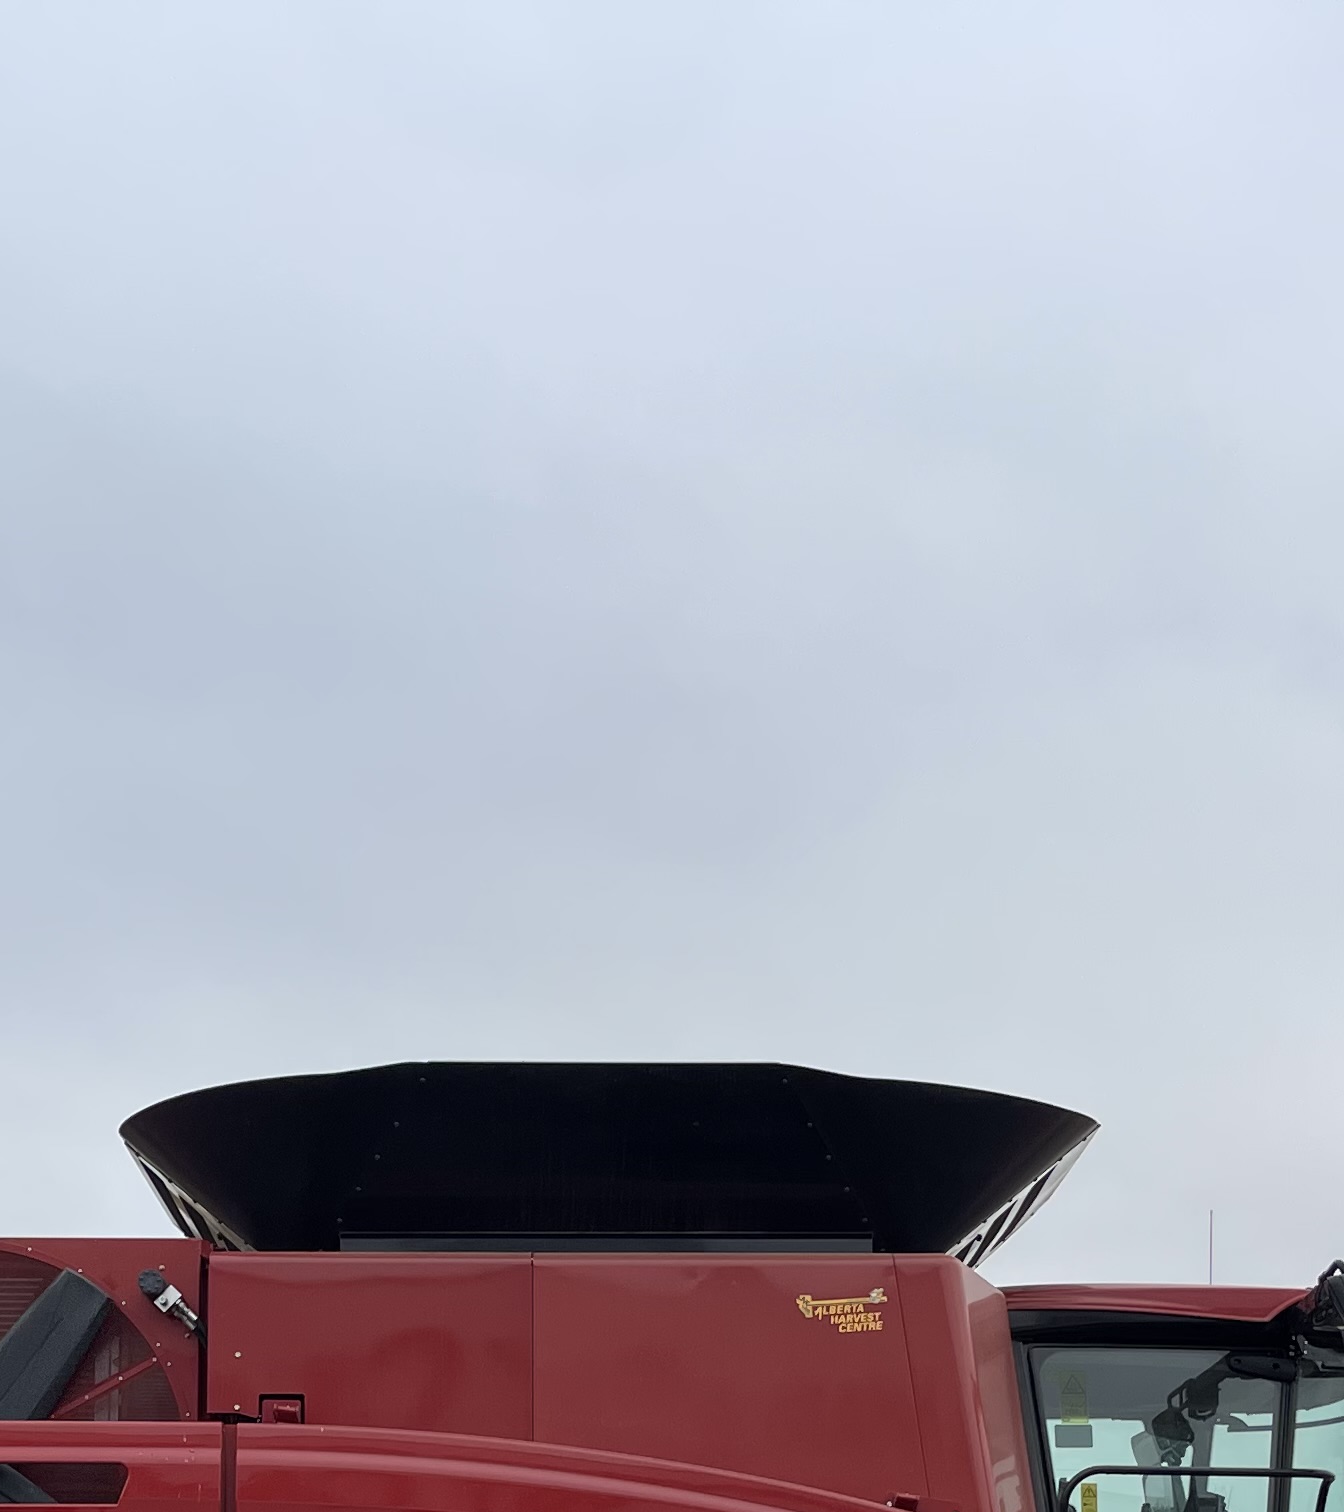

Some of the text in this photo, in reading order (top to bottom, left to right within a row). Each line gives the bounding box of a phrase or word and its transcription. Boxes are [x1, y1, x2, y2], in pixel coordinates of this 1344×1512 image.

[815, 1303, 864, 1320] ALBERTA
[830, 1312, 882, 1324] HARVEST
[838, 1321, 883, 1333] CENTRE
